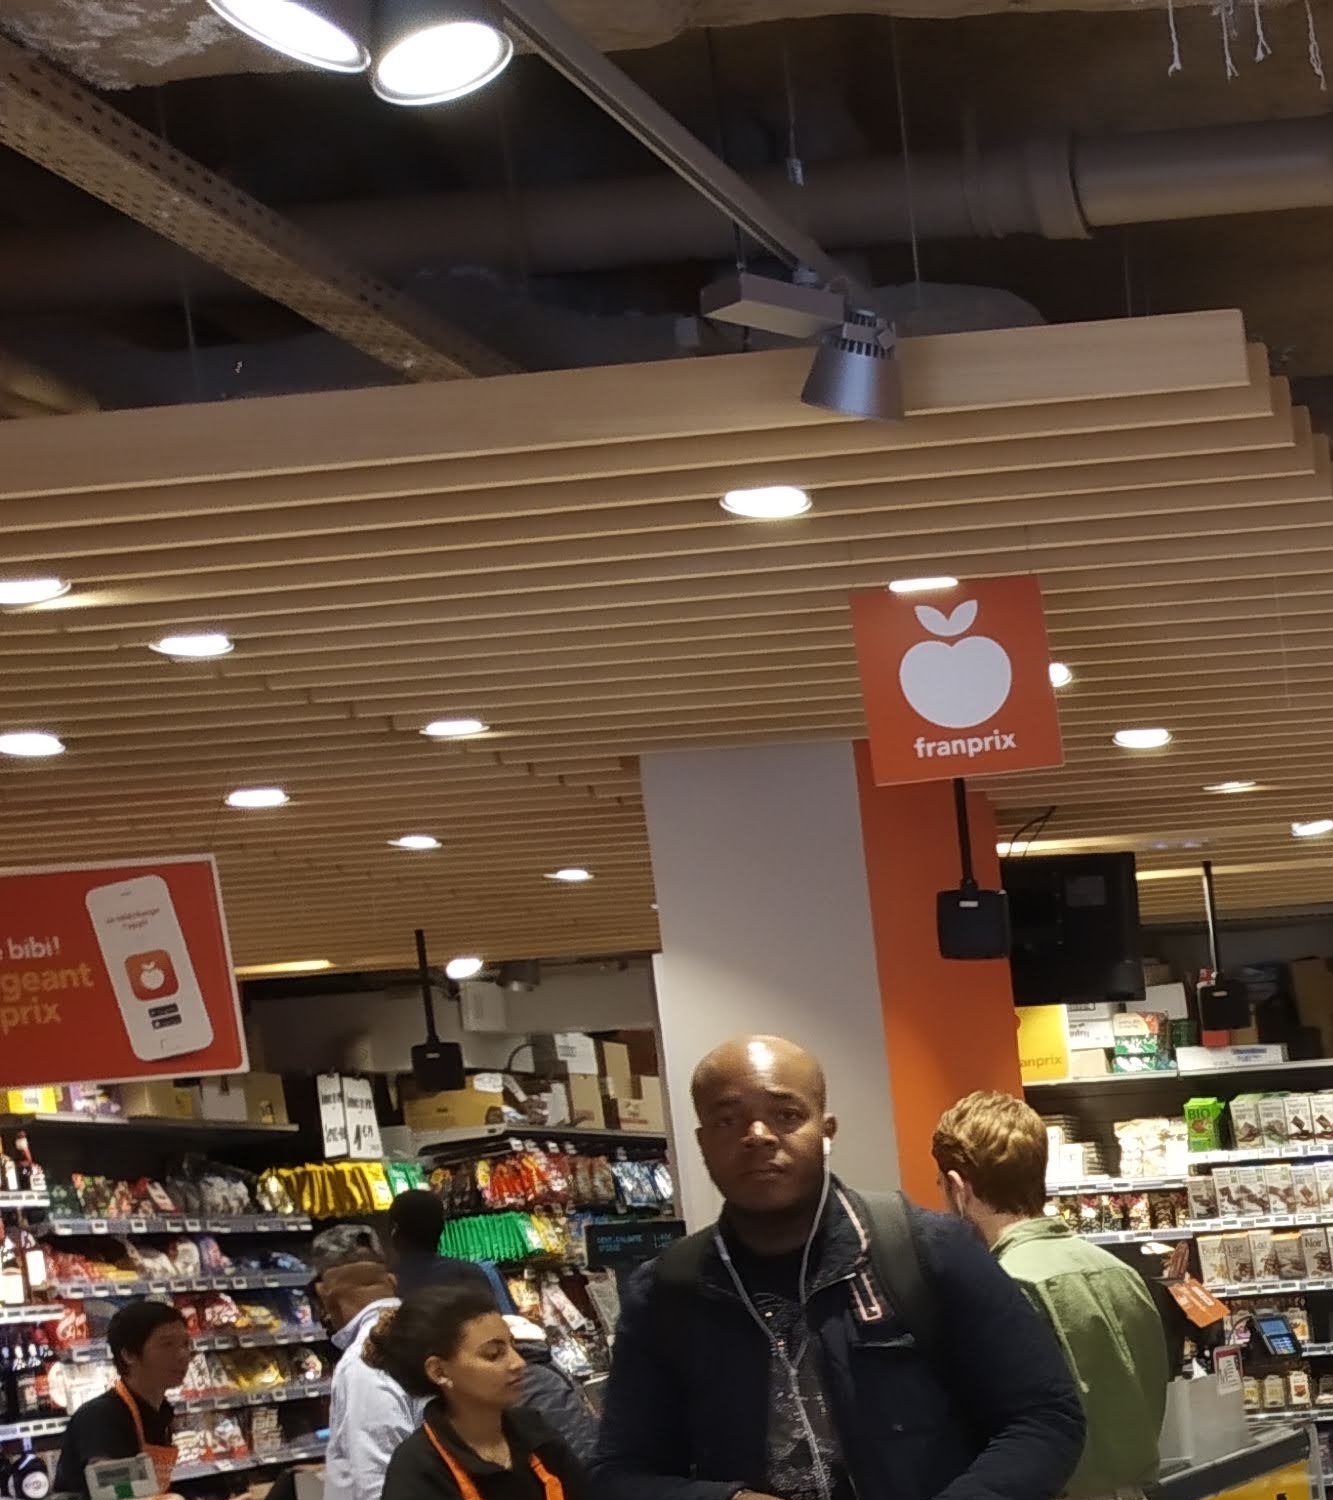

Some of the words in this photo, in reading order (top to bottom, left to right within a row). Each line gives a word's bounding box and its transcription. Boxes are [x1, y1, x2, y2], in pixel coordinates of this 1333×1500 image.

[913, 729, 1016, 758] franprix
[6, 935, 61, 960] bibi!
[1188, 1106, 1211, 1122] BIO
